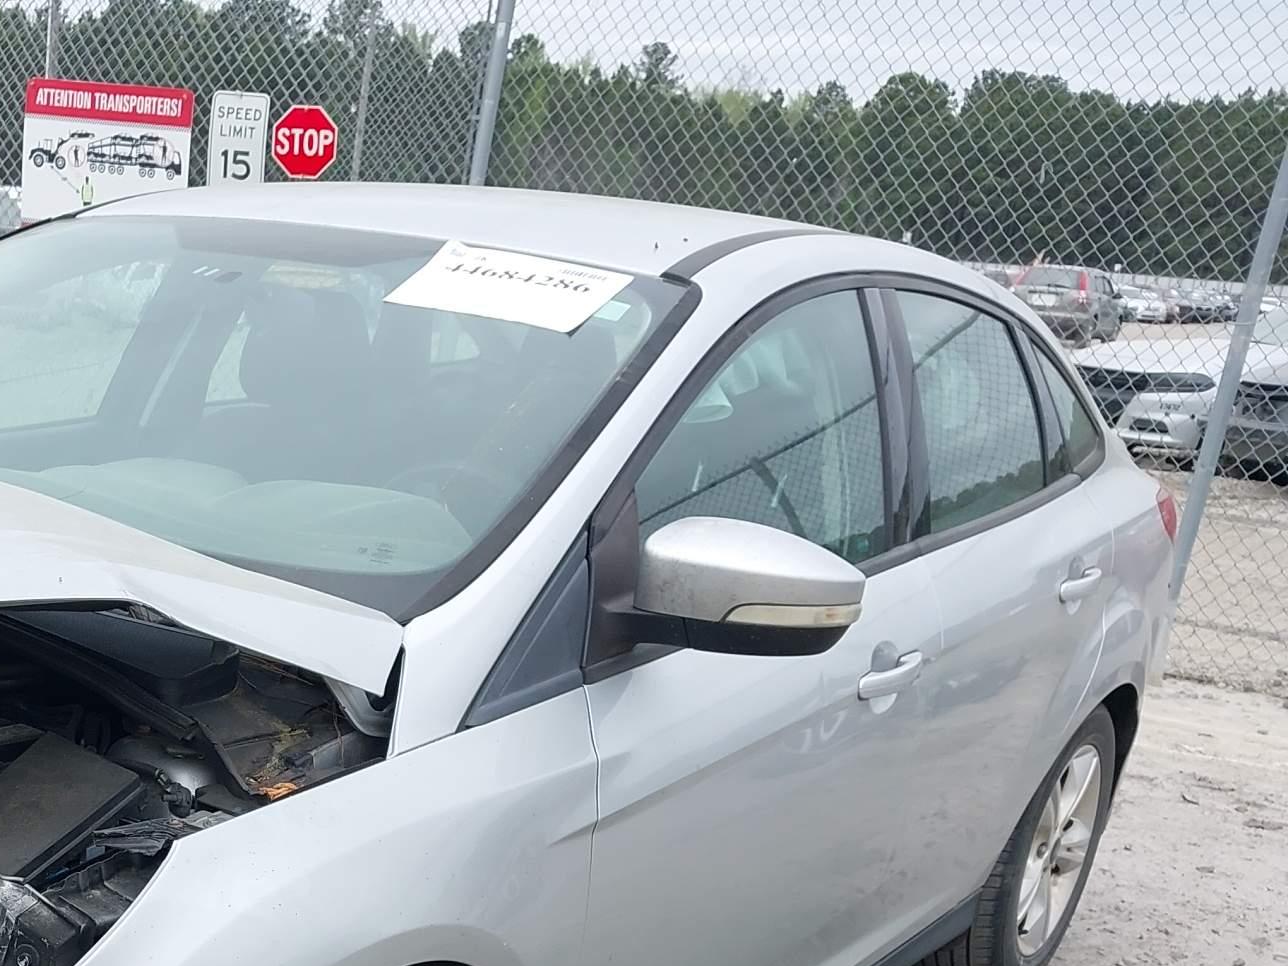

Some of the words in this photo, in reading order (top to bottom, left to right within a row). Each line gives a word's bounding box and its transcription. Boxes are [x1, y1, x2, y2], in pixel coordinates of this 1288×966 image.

[36, 88, 92, 110] ATTENTION
[94, 92, 183, 118] TRANSPORTERS!
[217, 106, 262, 121] SPEED
[220, 124, 256, 139] LIMIT
[275, 127, 334, 157] STOP
[221, 149, 251, 181] 15
